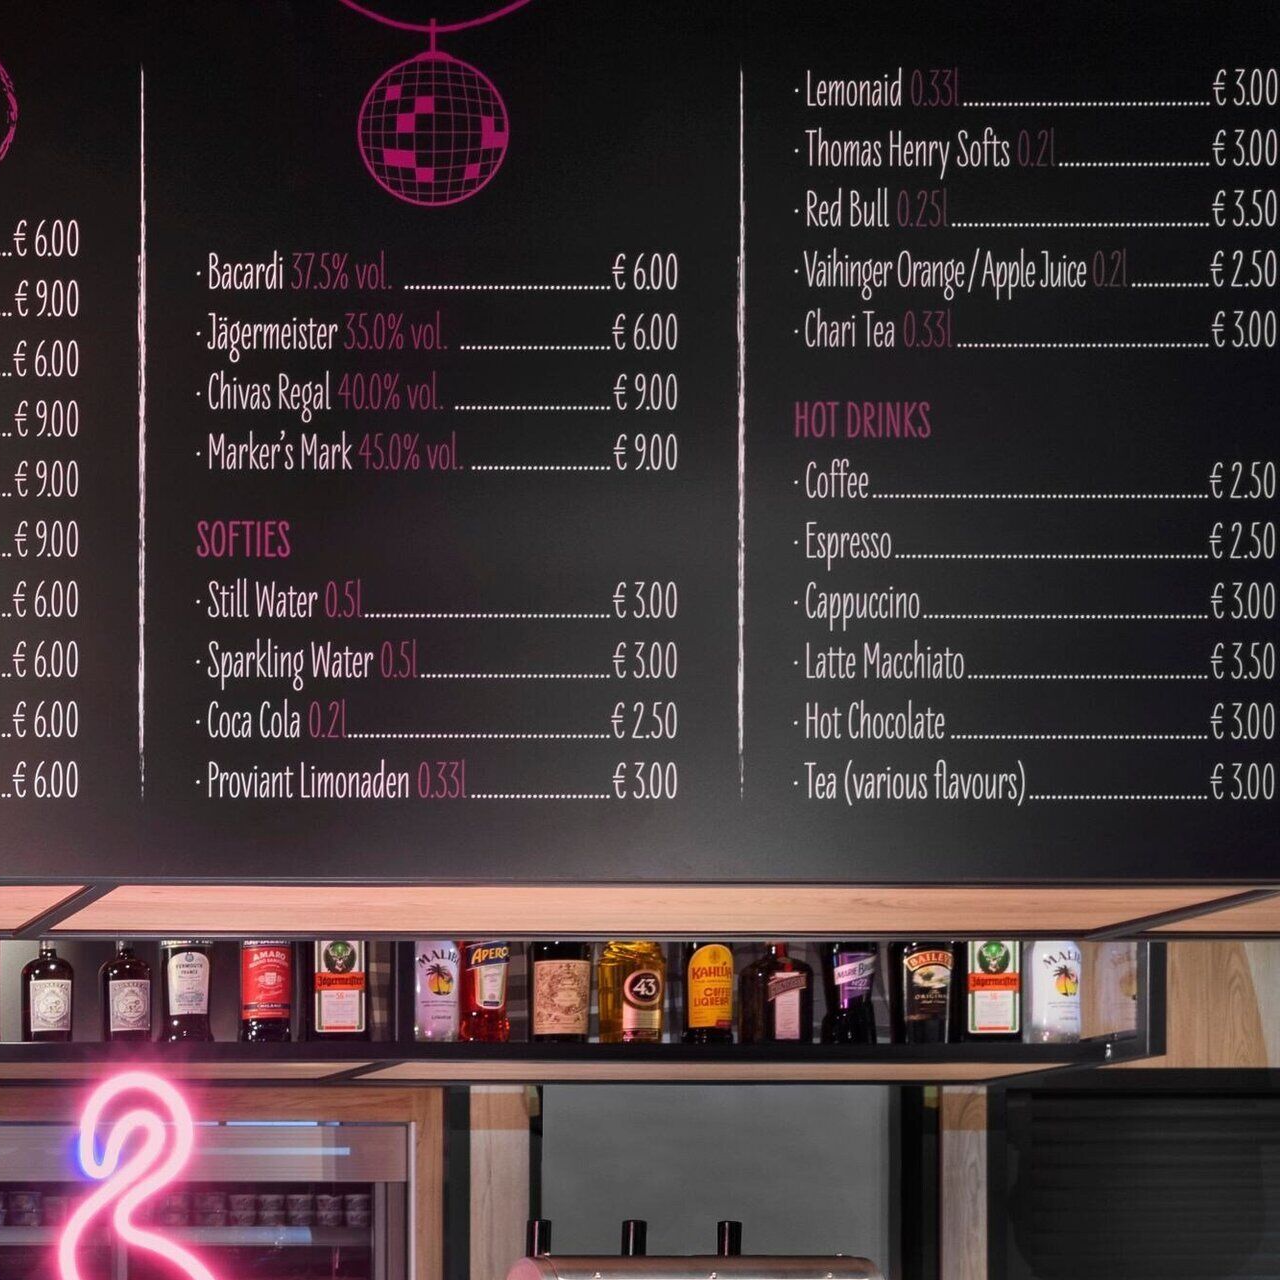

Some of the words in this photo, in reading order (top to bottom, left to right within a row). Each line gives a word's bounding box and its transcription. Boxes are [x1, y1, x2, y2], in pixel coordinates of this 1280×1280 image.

[805, 127, 881, 166] Thomas
[890, 131, 949, 179] Henry
[957, 127, 1010, 167] Softs
[35, 220, 78, 256] 6.00
[804, 248, 893, 300] Vaihinger
[898, 251, 964, 300] Orange
[982, 248, 1035, 300] Apple
[1040, 251, 1086, 287] Juice
[207, 313, 338, 362] Jägermeister
[795, 402, 838, 437] HOT
[847, 402, 930, 438] DRINKS
[209, 430, 293, 469] Marker's
[302, 431, 352, 470] Mark
[359, 433, 420, 470] 45.0%
[427, 432, 463, 470] vol.
[635, 434, 677, 470] 9.00
[197, 521, 290, 557] SOFTIES
[208, 578, 249, 617] Still
[256, 581, 318, 617] Water
[806, 582, 919, 631] Cappuccino
[807, 642, 856, 678] Latte
[864, 640, 964, 679] Macchiato
[804, 762, 836, 799] Tea
[845, 760, 927, 806] (various
[934, 760, 1025, 806] flavours)
[253, 951, 286, 961] AMARO
[471, 946, 509, 965] APERO
[633, 979, 656, 995] 43
